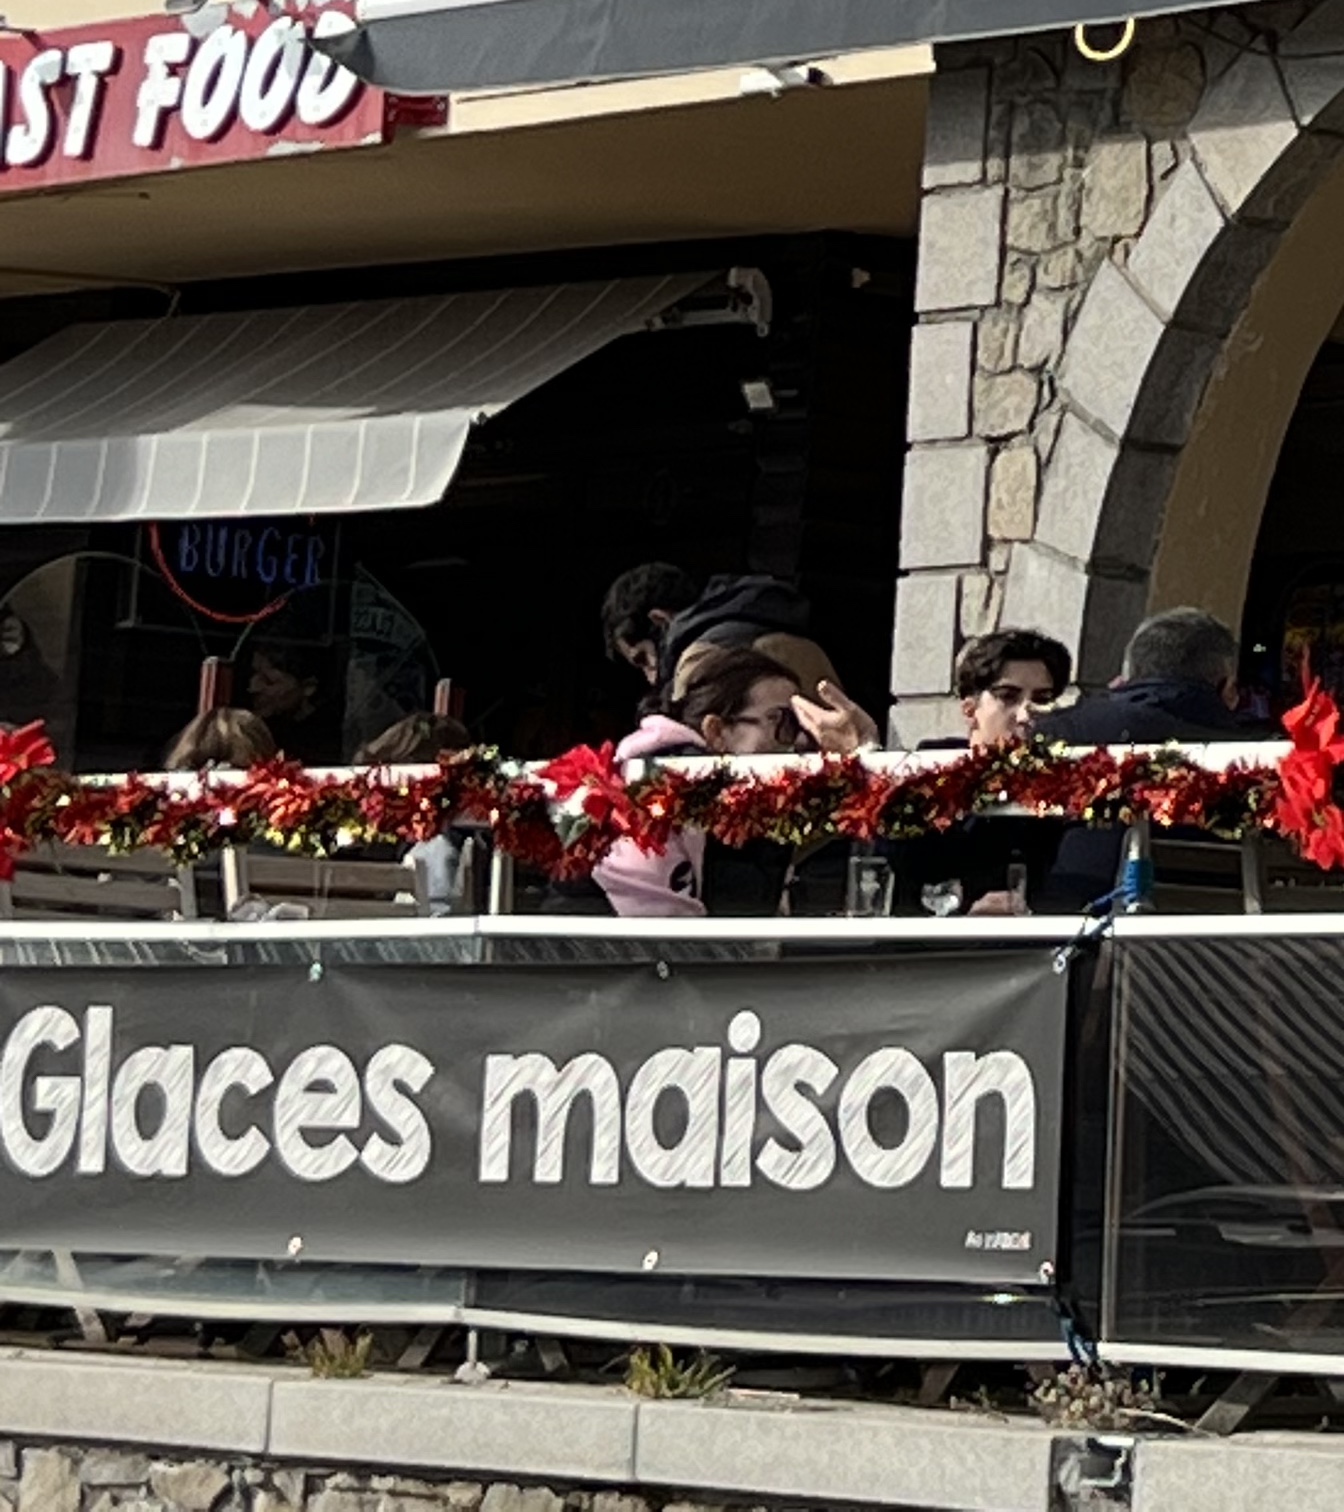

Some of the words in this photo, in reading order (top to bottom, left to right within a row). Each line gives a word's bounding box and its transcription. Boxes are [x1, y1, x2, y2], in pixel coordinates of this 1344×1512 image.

[0, 40, 117, 166] ST
[178, 523, 325, 586] BURGER
[0, 1004, 435, 1183] Glaces
[479, 1010, 1036, 1190] maison
